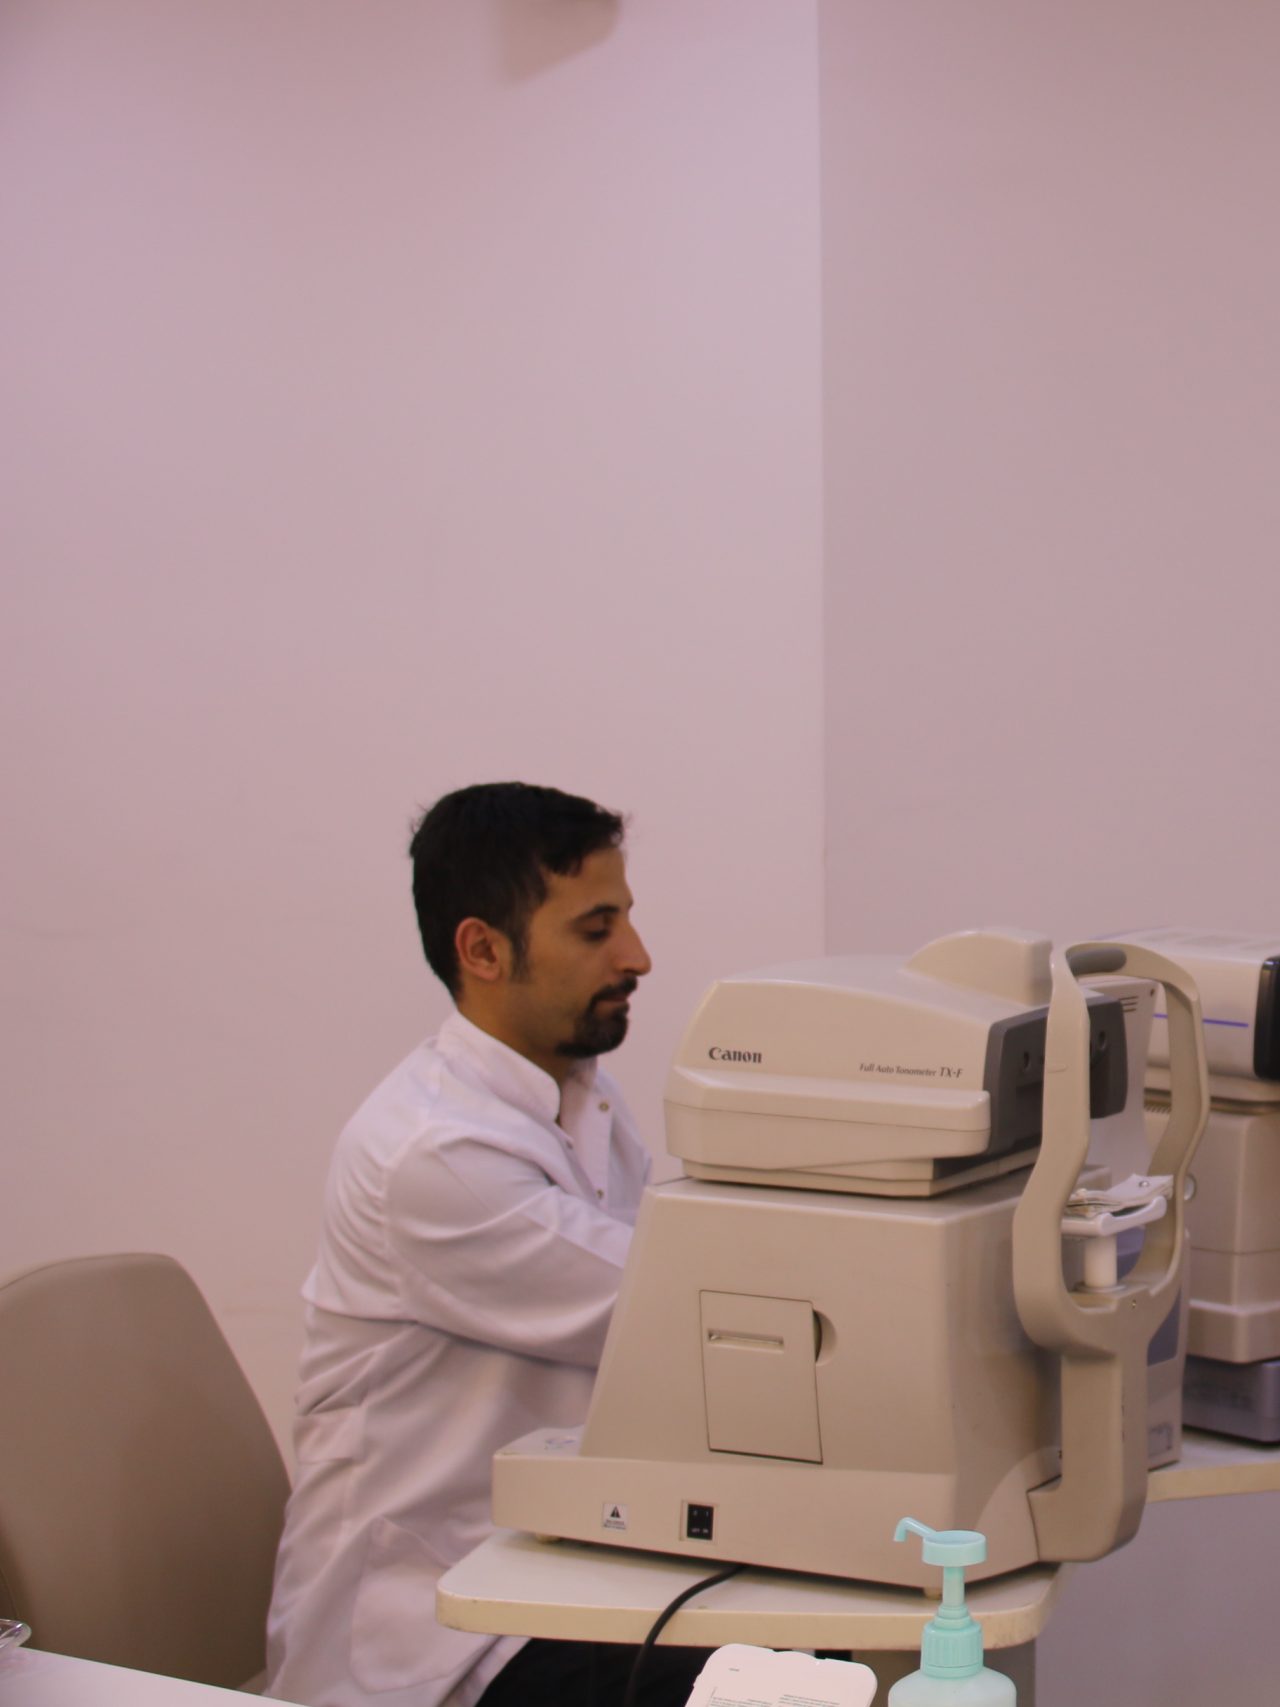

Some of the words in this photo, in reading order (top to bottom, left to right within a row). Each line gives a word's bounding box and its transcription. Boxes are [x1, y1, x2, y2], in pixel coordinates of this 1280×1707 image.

[708, 1046, 763, 1064] Canon
[859, 1062, 876, 1073] Full
[876, 1064, 895, 1075] Auto
[895, 1065, 938, 1077] Tonometer
[939, 1066, 964, 1079] TX-F
